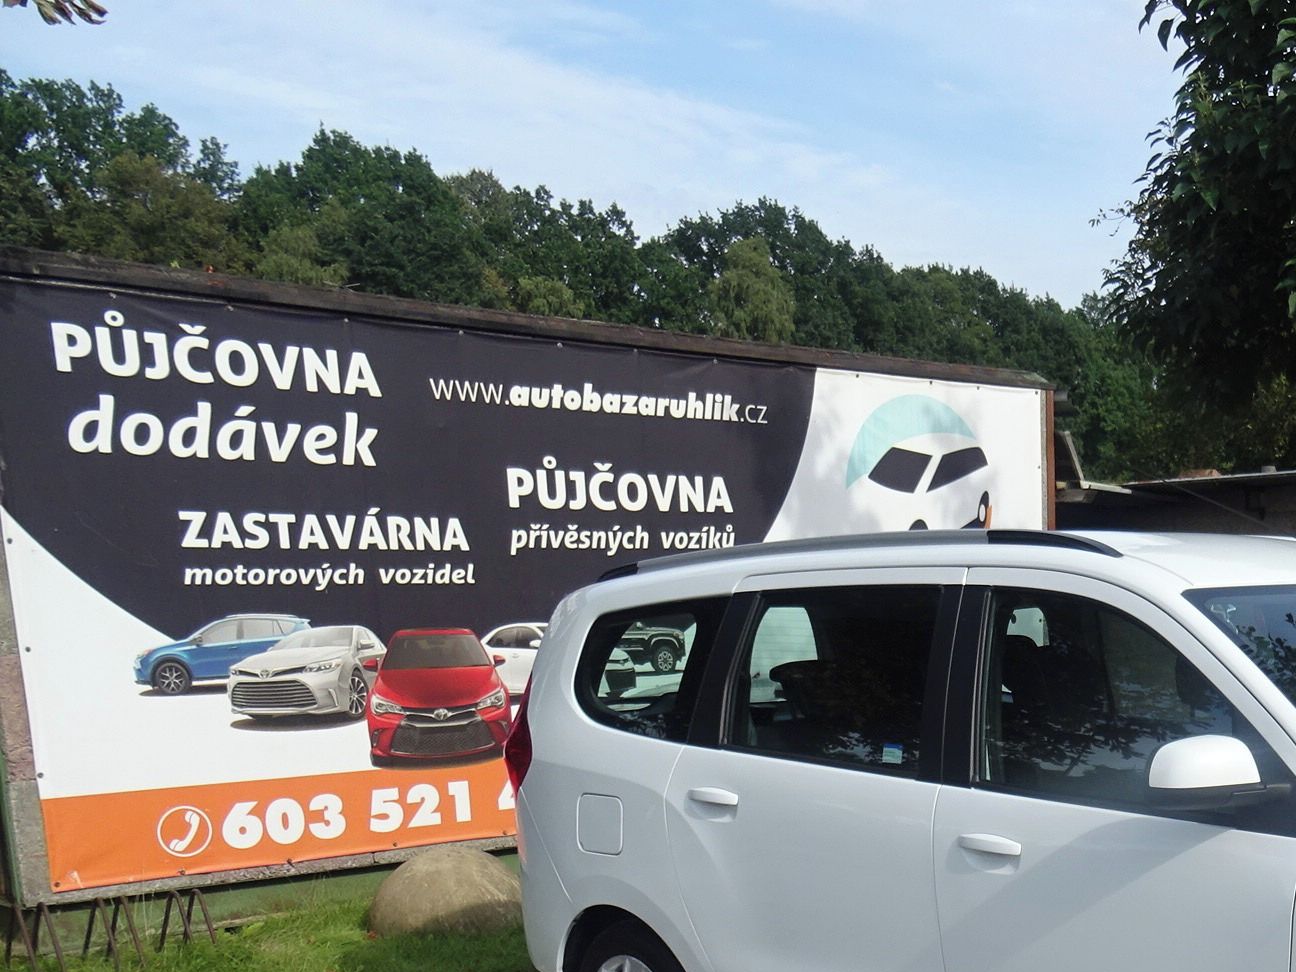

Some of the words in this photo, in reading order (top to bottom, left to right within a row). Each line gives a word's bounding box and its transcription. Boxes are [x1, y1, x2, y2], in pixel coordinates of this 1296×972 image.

[50, 310, 383, 397] PŮJČOVNA
[429, 377, 769, 424] www.autobazaruhlik.cz
[67, 394, 379, 467] dodávek
[506, 455, 734, 513] PŮJČOVNA
[178, 507, 470, 551] ZASTAVÁRNA
[510, 523, 649, 556] přívěsných
[660, 524, 736, 549] vozíků
[184, 562, 365, 592] motorových
[379, 563, 476, 585] vozidel
[221, 793, 347, 850] 603
[369, 780, 472, 833] 521
